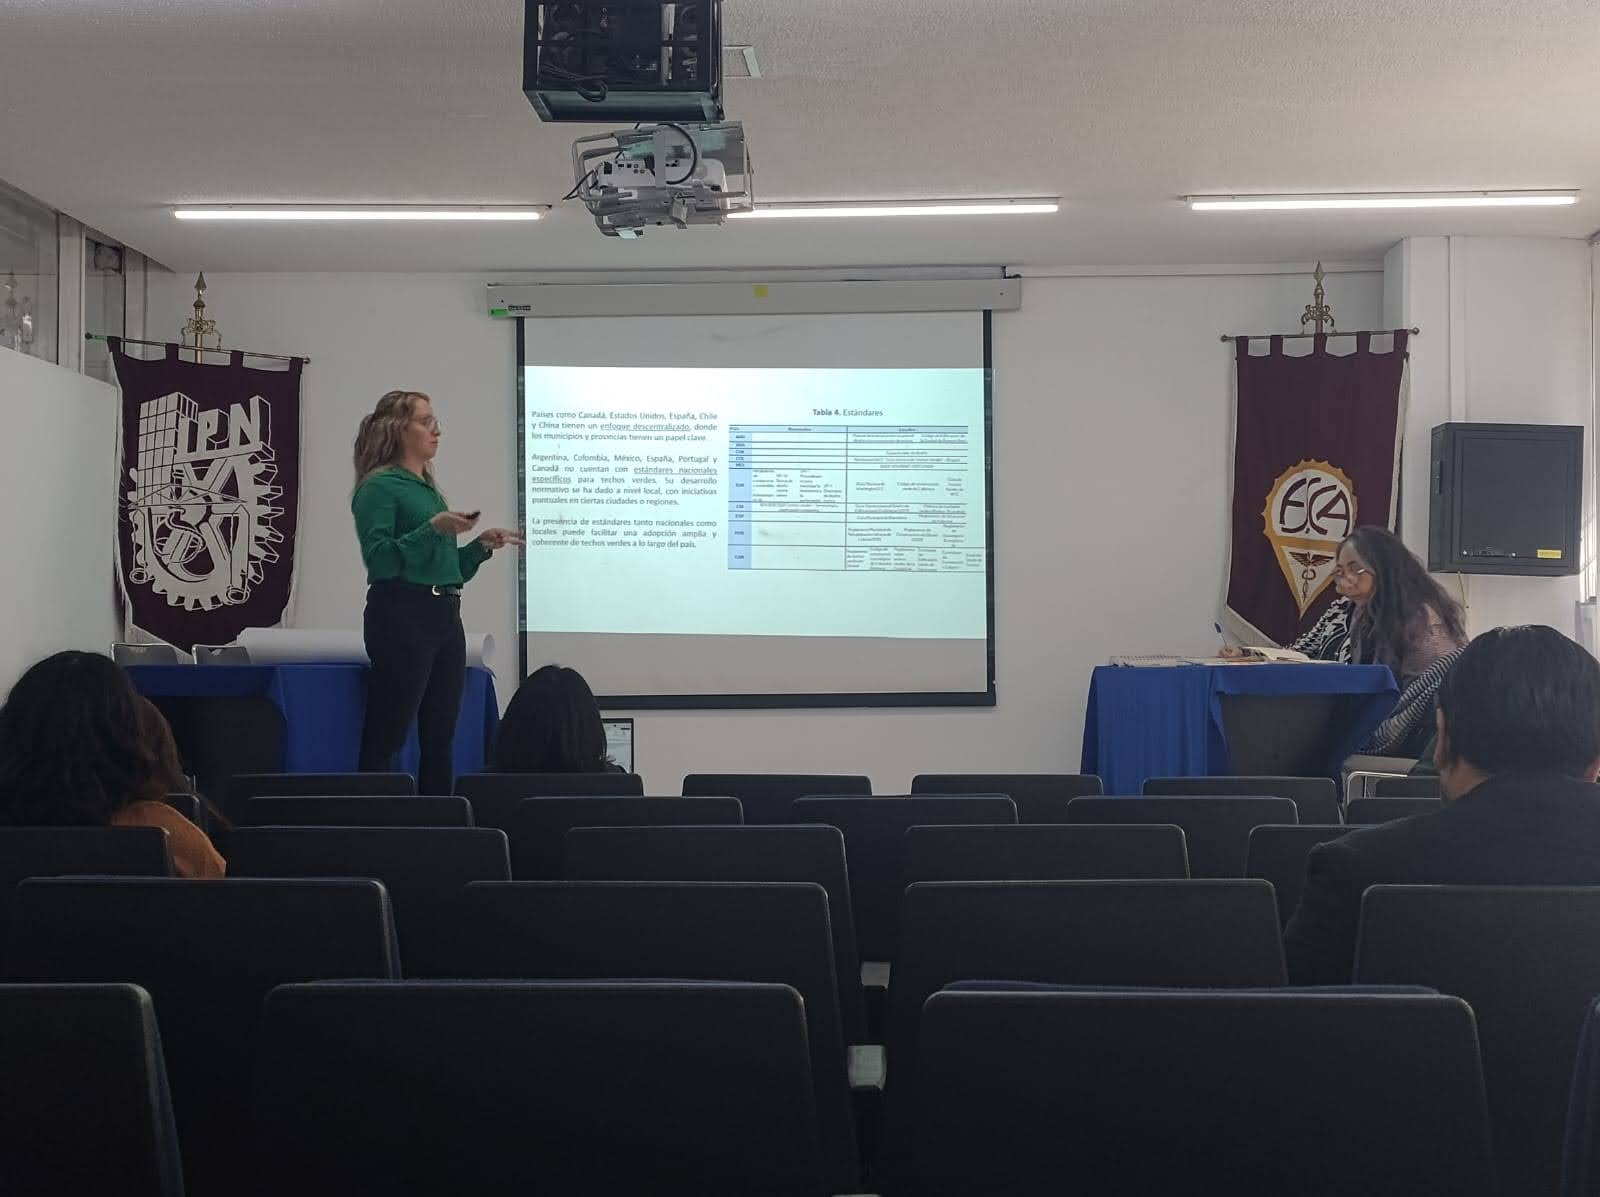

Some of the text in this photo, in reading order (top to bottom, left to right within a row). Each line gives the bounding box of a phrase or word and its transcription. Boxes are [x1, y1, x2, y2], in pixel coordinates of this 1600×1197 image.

[176, 396, 270, 461] IPN
[834, 409, 842, 417] 4.
[842, 409, 884, 417] Estándares
